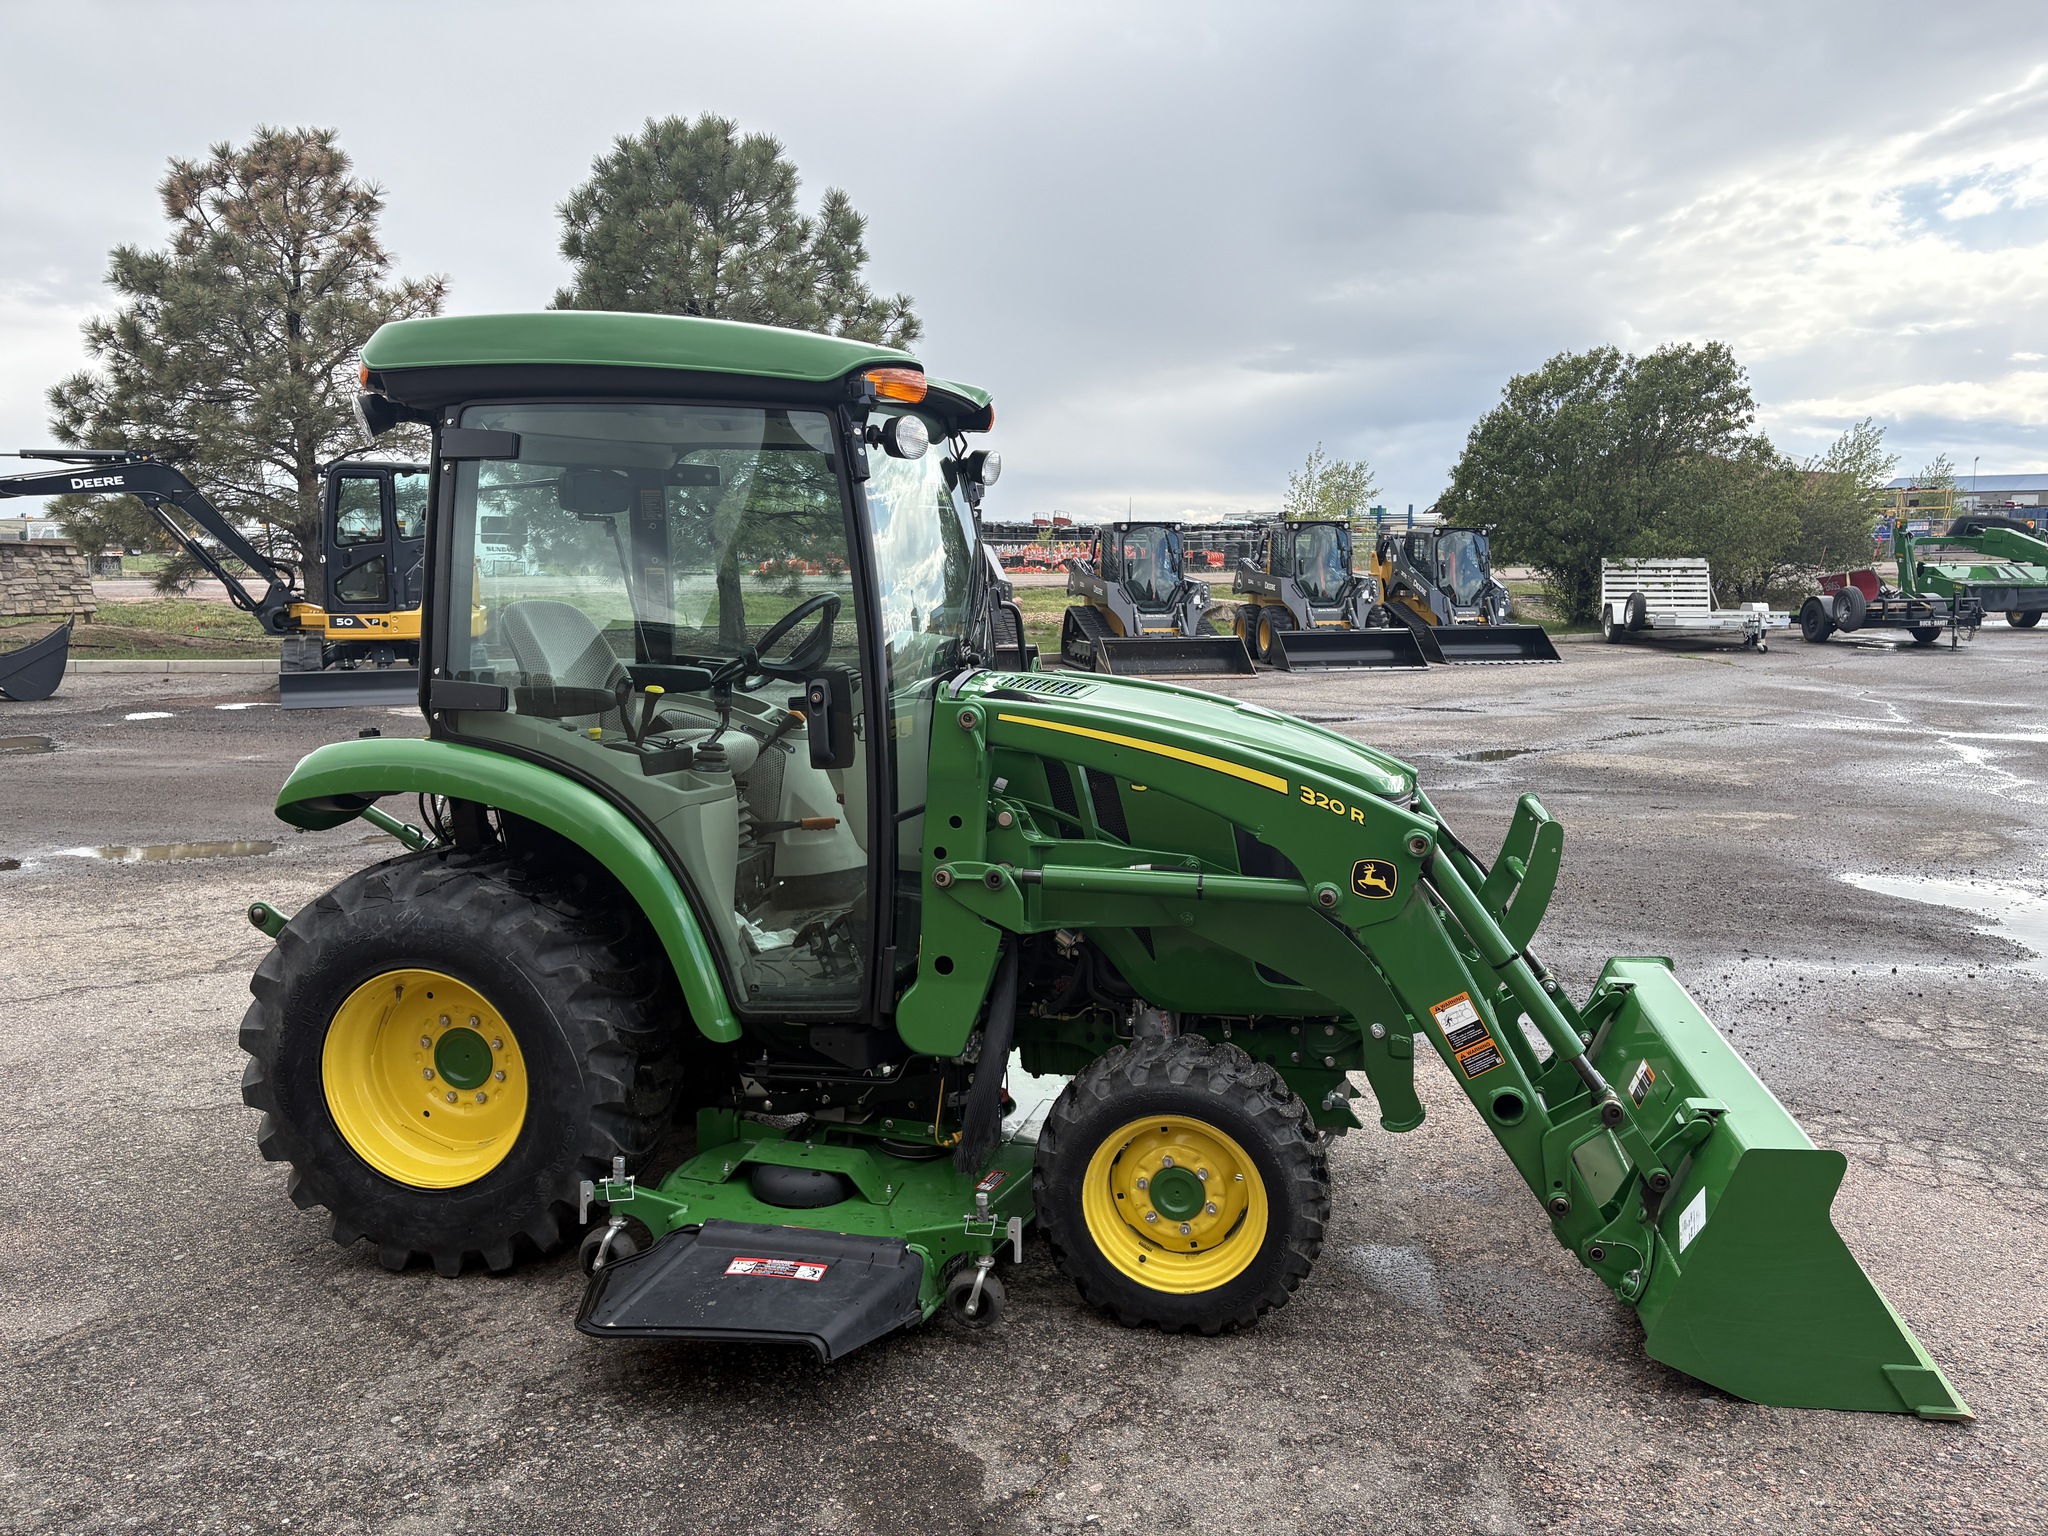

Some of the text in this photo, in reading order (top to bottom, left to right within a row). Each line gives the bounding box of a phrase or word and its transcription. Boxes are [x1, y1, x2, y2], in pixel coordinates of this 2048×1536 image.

[70, 475, 125, 490] DEERE
[336, 618, 379, 626] 50 P
[1300, 785, 1366, 826] 320 R
[1441, 996, 1465, 1009] WARNING
[1467, 1042, 1491, 1056] WARNING
